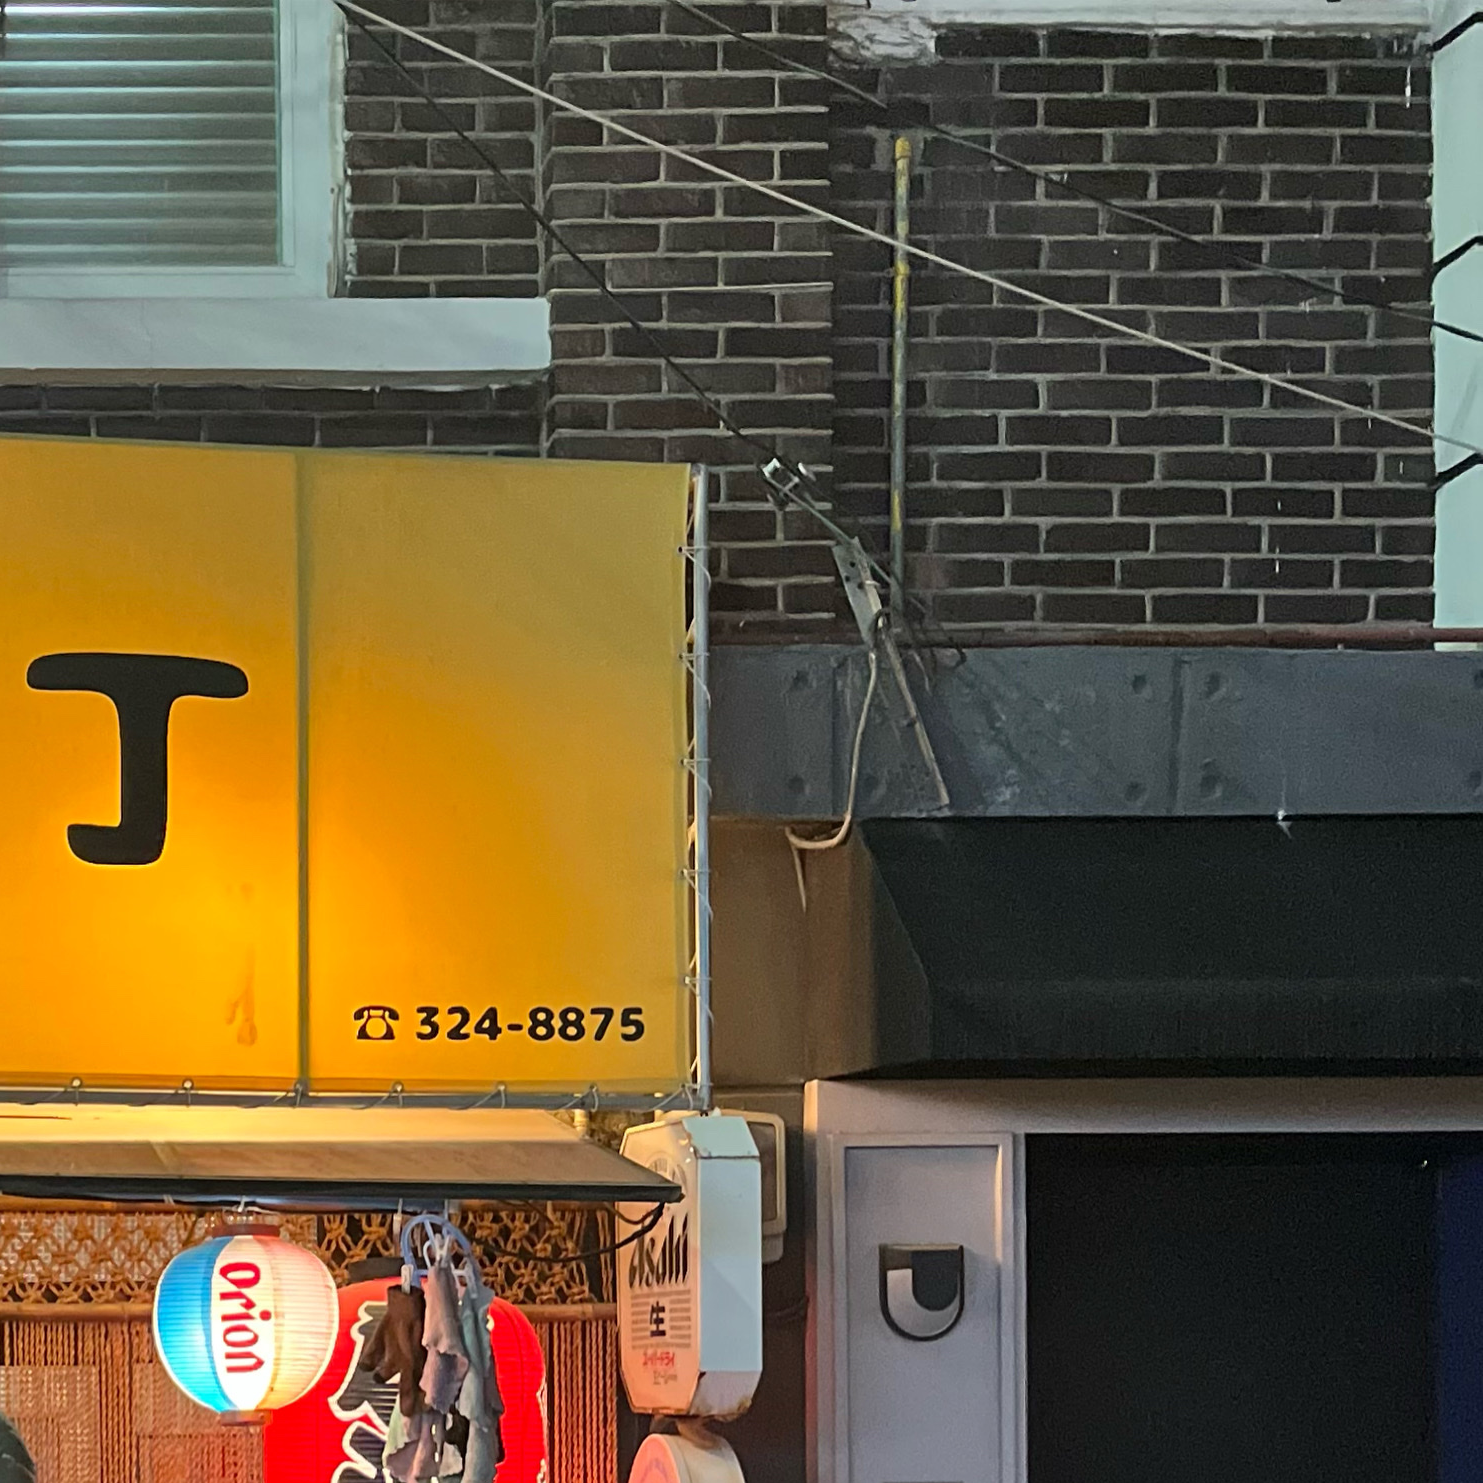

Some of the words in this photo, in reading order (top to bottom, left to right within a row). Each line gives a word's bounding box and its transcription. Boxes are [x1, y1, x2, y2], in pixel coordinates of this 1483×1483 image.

[416, 1006, 645, 1041] 324-8875
[219, 1261, 272, 1373] Orion
[649, 1300, 666, 1338] 生
